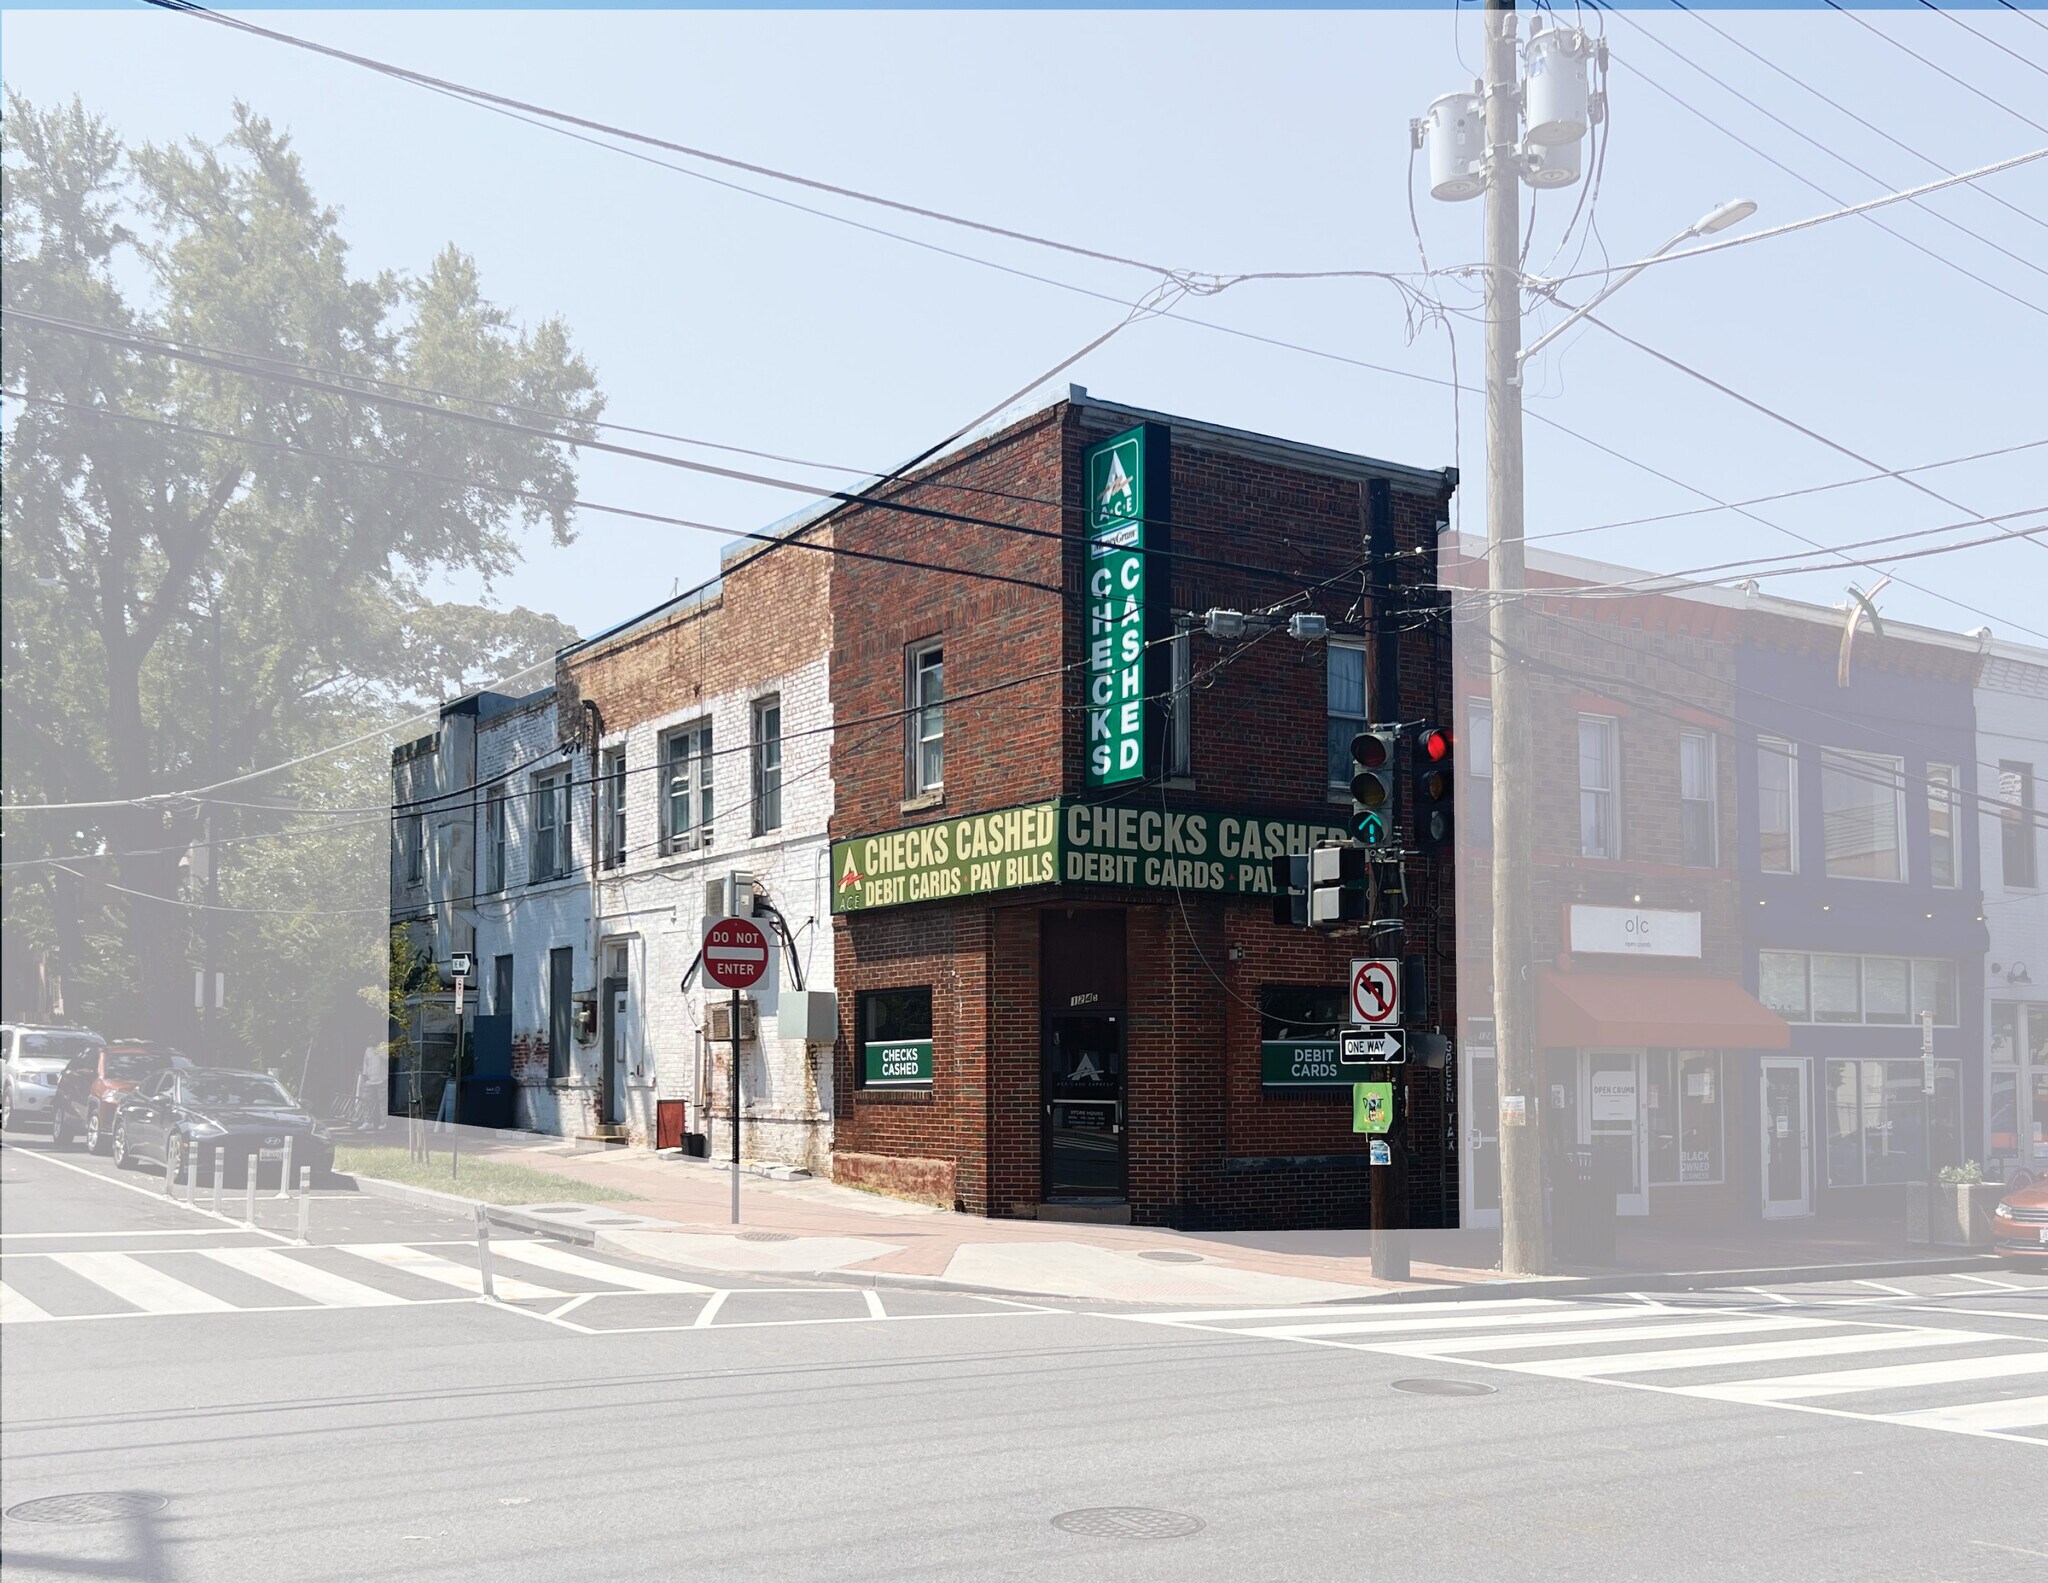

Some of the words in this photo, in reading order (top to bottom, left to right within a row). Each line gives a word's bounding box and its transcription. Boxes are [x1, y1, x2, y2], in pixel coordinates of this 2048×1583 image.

[1120, 557, 1140, 771] CASHED
[1091, 568, 1112, 776] CHECKS
[1067, 804, 1207, 855] CHECKS
[865, 825, 949, 876] CHECKS
[956, 805, 1054, 860] CASHED
[1067, 851, 1137, 884] DEBIT
[1145, 857, 1224, 890] CARDS
[865, 876, 906, 906] DEBIT
[910, 867, 961, 900] CARDS
[970, 860, 1001, 891] PAY
[1006, 851, 1053, 886] BILLS
[840, 895, 860, 910] ACE
[713, 931, 729, 943] DO
[736, 932, 759, 944] NOT
[717, 963, 755, 975] ENTER
[1347, 1041, 1364, 1053] ONE
[1367, 1040, 1385, 1053] WAY
[882, 1048, 918, 1062] CHECKS
[1294, 1049, 1334, 1062] DEBIT
[882, 1062, 919, 1076] CASHED
[1291, 1064, 1338, 1077] CARDS
[1594, 1086, 1612, 1094] OPEN
[1612, 1086, 1635, 1094] CRUMB
[1681, 1151, 1709, 1161] BLACK
[1680, 1162, 1709, 1171] OWNED
